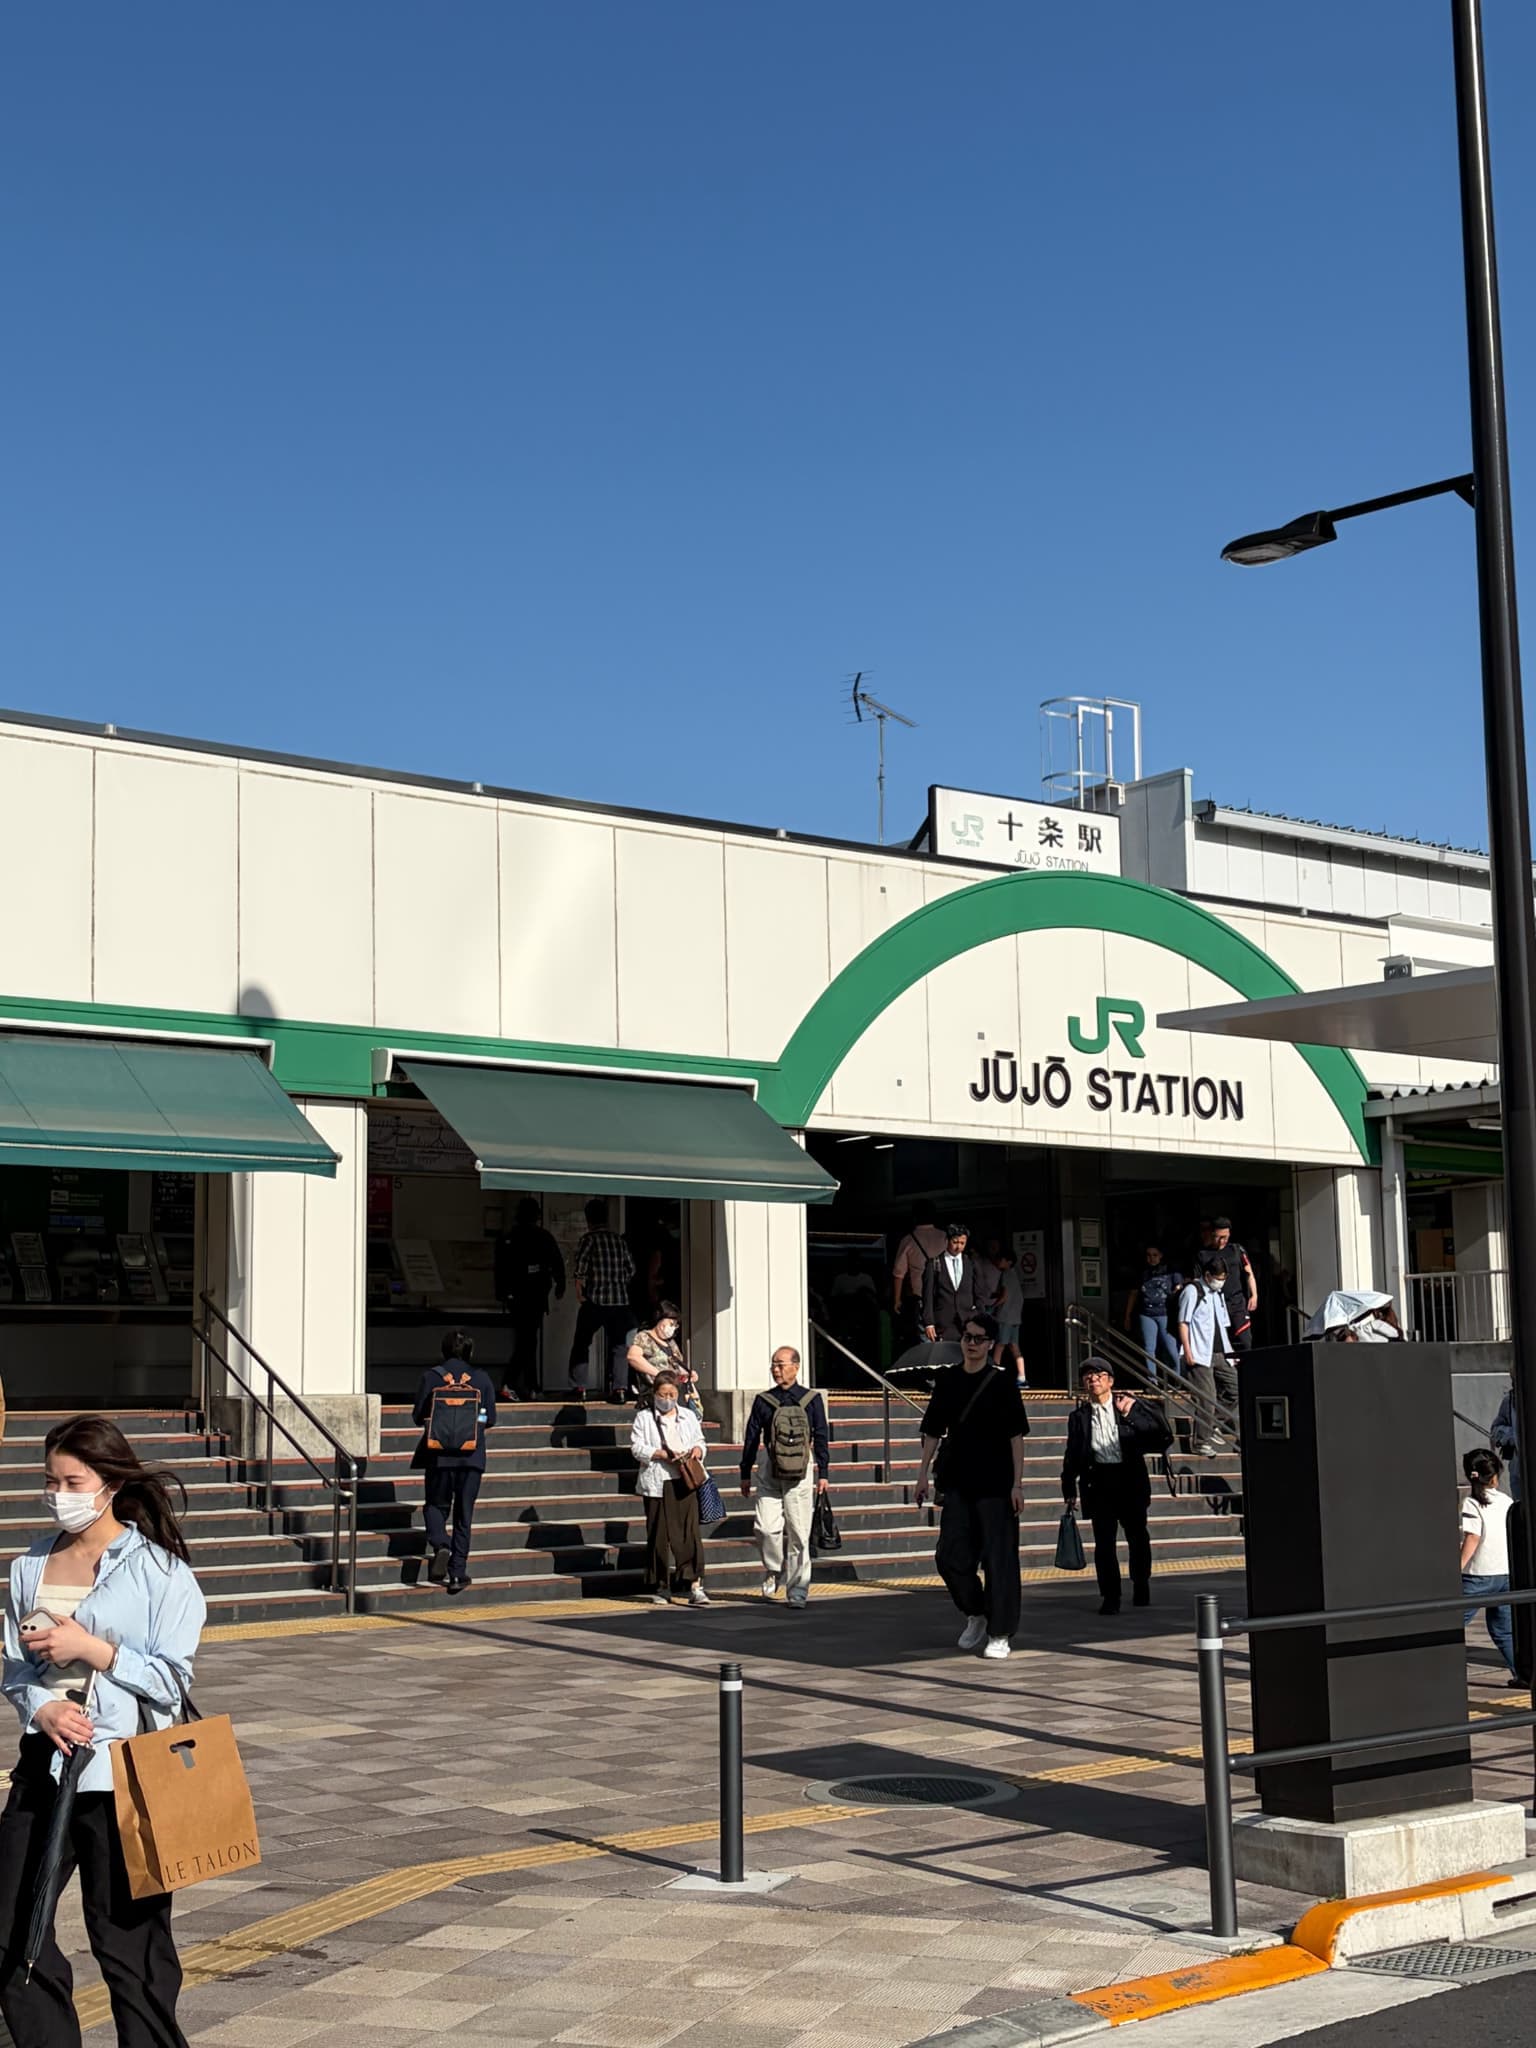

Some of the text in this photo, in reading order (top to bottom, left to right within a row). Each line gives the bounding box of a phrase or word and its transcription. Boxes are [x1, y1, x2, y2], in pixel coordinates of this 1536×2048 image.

[951, 813, 985, 841] JR
[998, 811, 1103, 854] 十条駅
[1046, 855, 1089, 872] STATION
[1067, 996, 1147, 1059] JR
[969, 1051, 1245, 1121] JŪJŌ STATION
[165, 1839, 257, 1883] LE TALON
